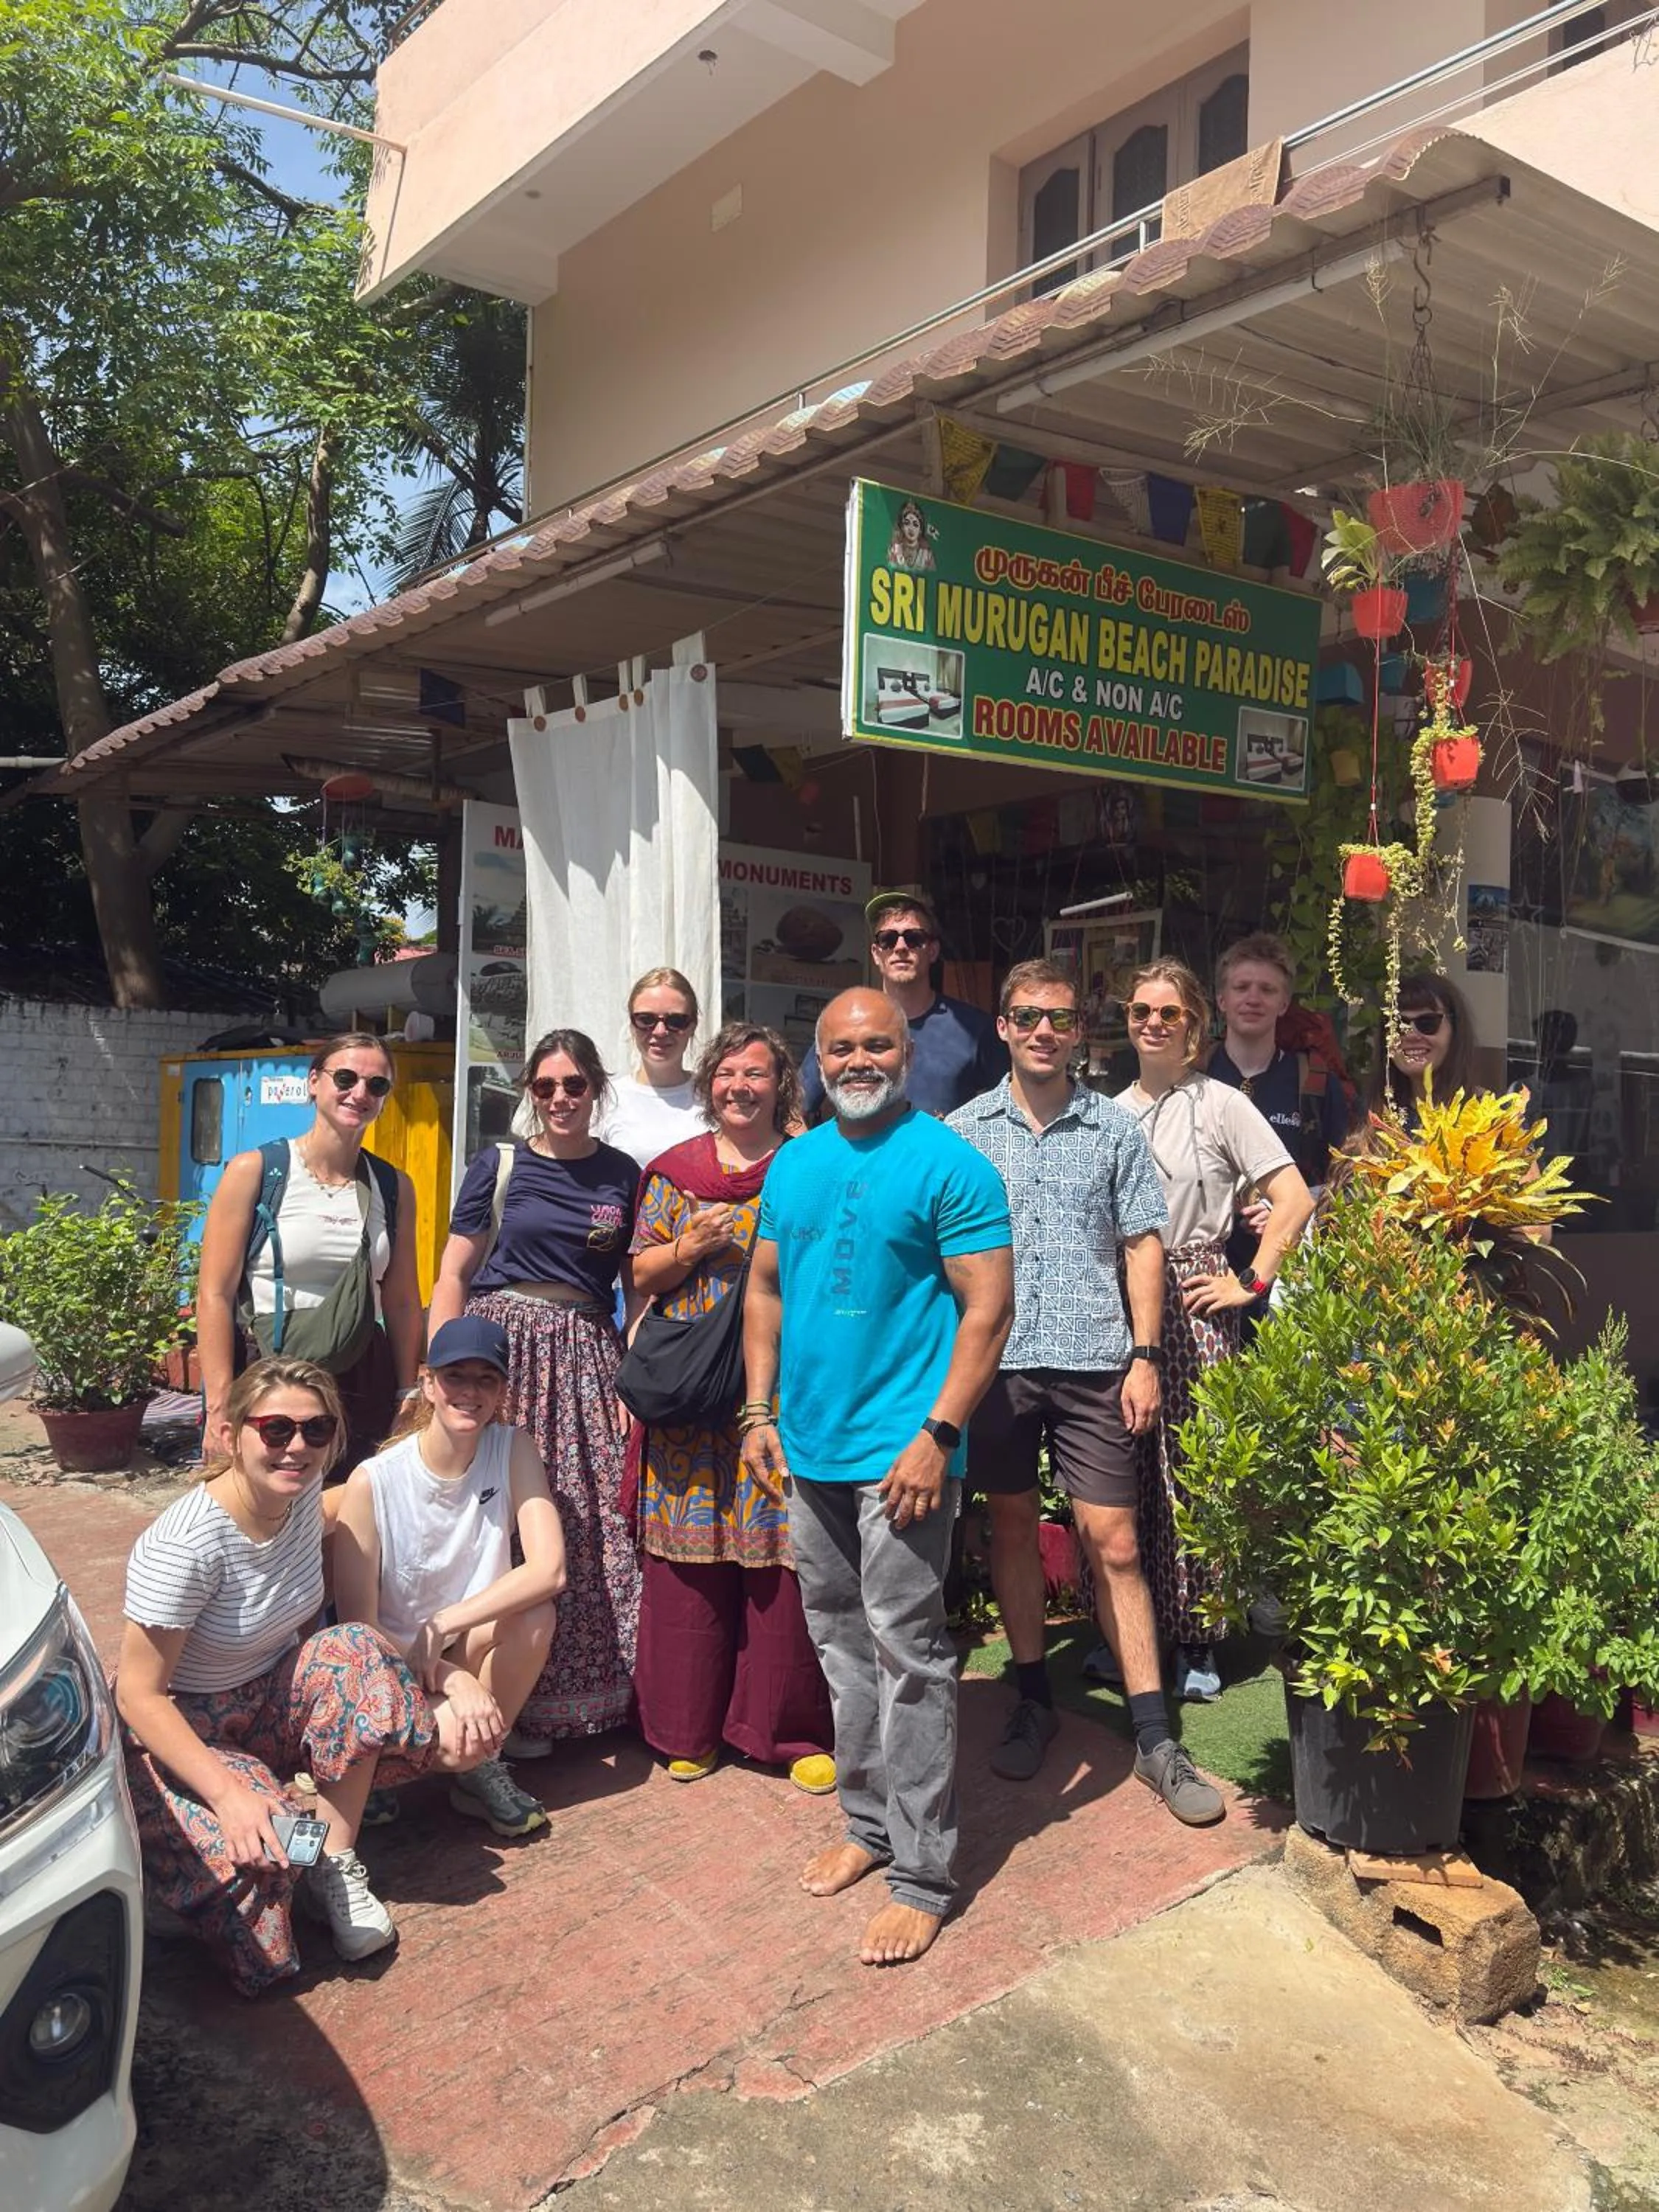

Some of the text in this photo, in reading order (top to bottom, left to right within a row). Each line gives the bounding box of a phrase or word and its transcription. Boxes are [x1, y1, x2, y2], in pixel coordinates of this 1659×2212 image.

[975, 546, 1091, 597] முருகன்
[1094, 564, 1133, 605] பீச்
[870, 568, 1310, 709] SRI MURUGAN BEACH PARADISE
[1026, 667, 1183, 720] A/C & NON A/C
[973, 695, 1227, 773] ROOMS AVAILABLE
[718, 859, 852, 895] MONUMENTS
